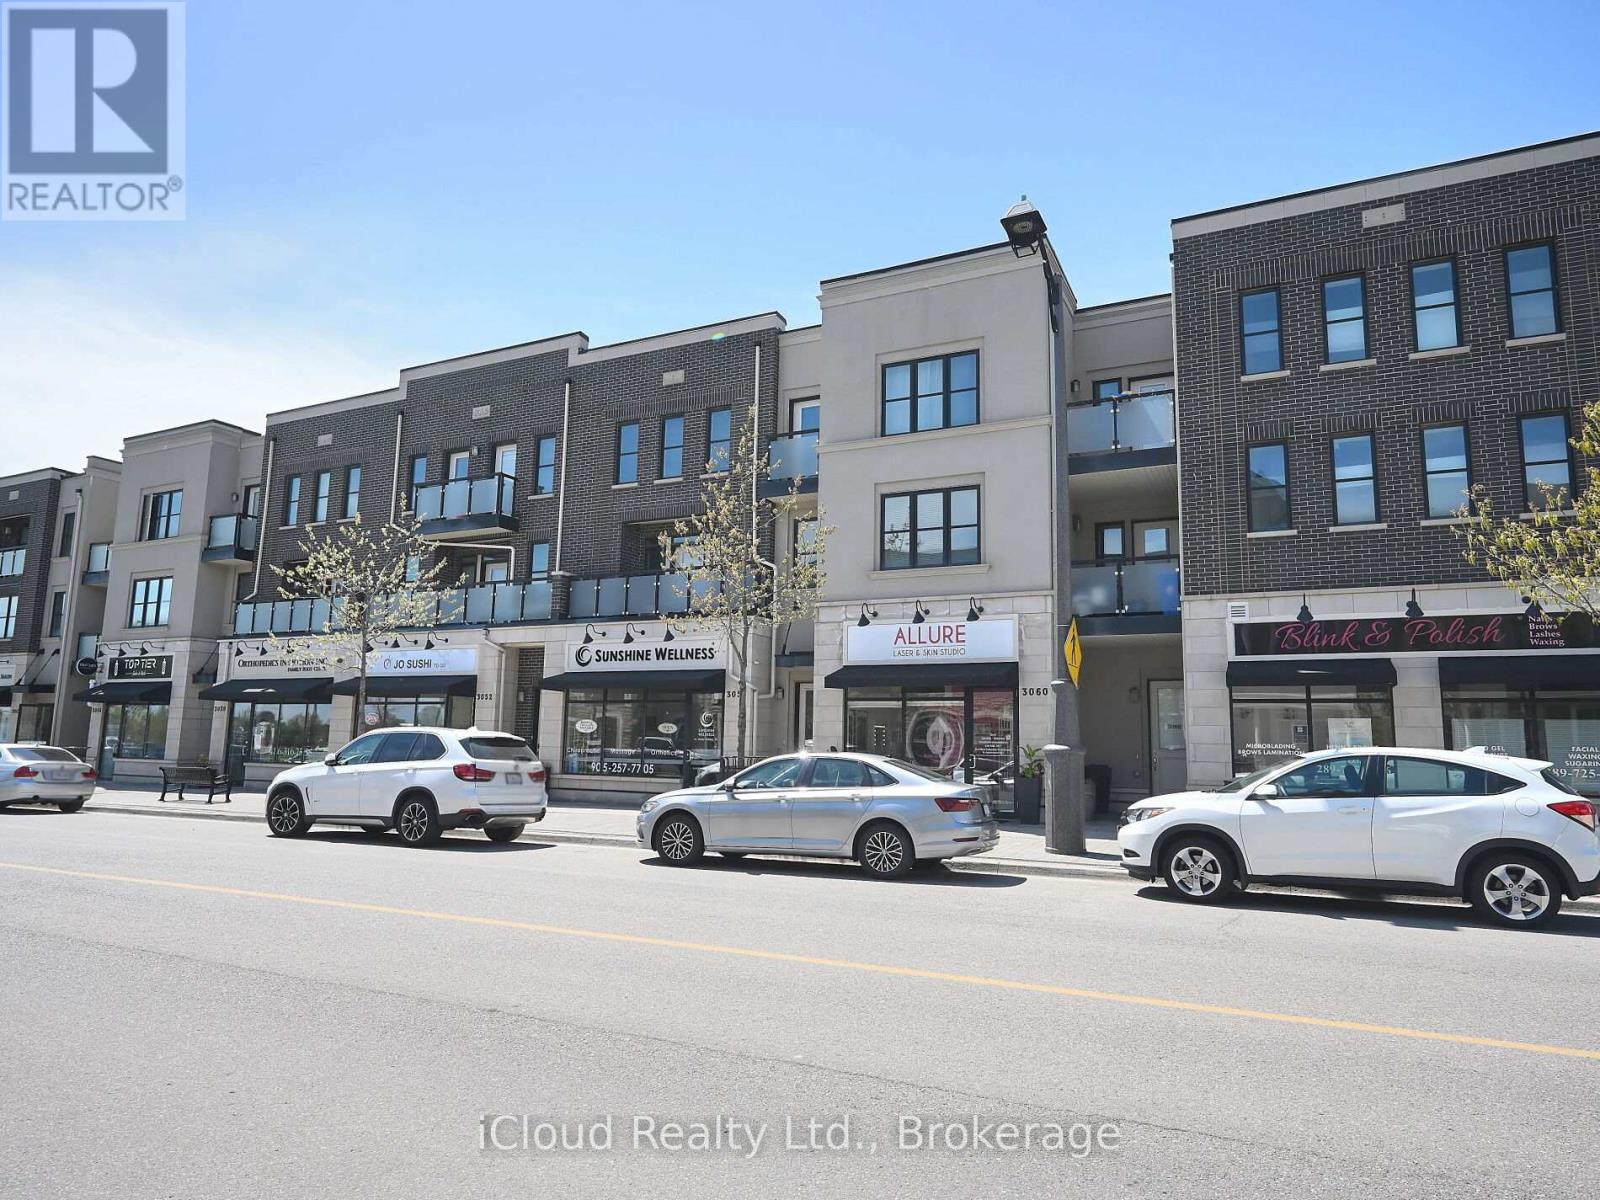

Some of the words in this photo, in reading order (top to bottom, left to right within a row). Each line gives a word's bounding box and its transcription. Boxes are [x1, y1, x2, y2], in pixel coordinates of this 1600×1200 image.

[894, 624, 966, 645] ALLURE
[1275, 622, 1361, 650] Blink
[1364, 620, 1393, 645] &
[1404, 617, 1505, 645] Polish
[1530, 630, 1561, 638] Lashes
[1530, 638, 1565, 647] Waxing
[595, 649, 651, 662] SUNSHINE
[654, 647, 715, 660] WELLNESS
[893, 649, 914, 657] LASER
[923, 648, 938, 656] SKIN
[940, 647, 966, 656] STUDIO
[124, 659, 140, 669] TOP
[141, 658, 157, 669] TIER
[393, 659, 405, 669] JO
[406, 659, 432, 669] SUSHI
[1022, 687, 1048, 696] 3060
